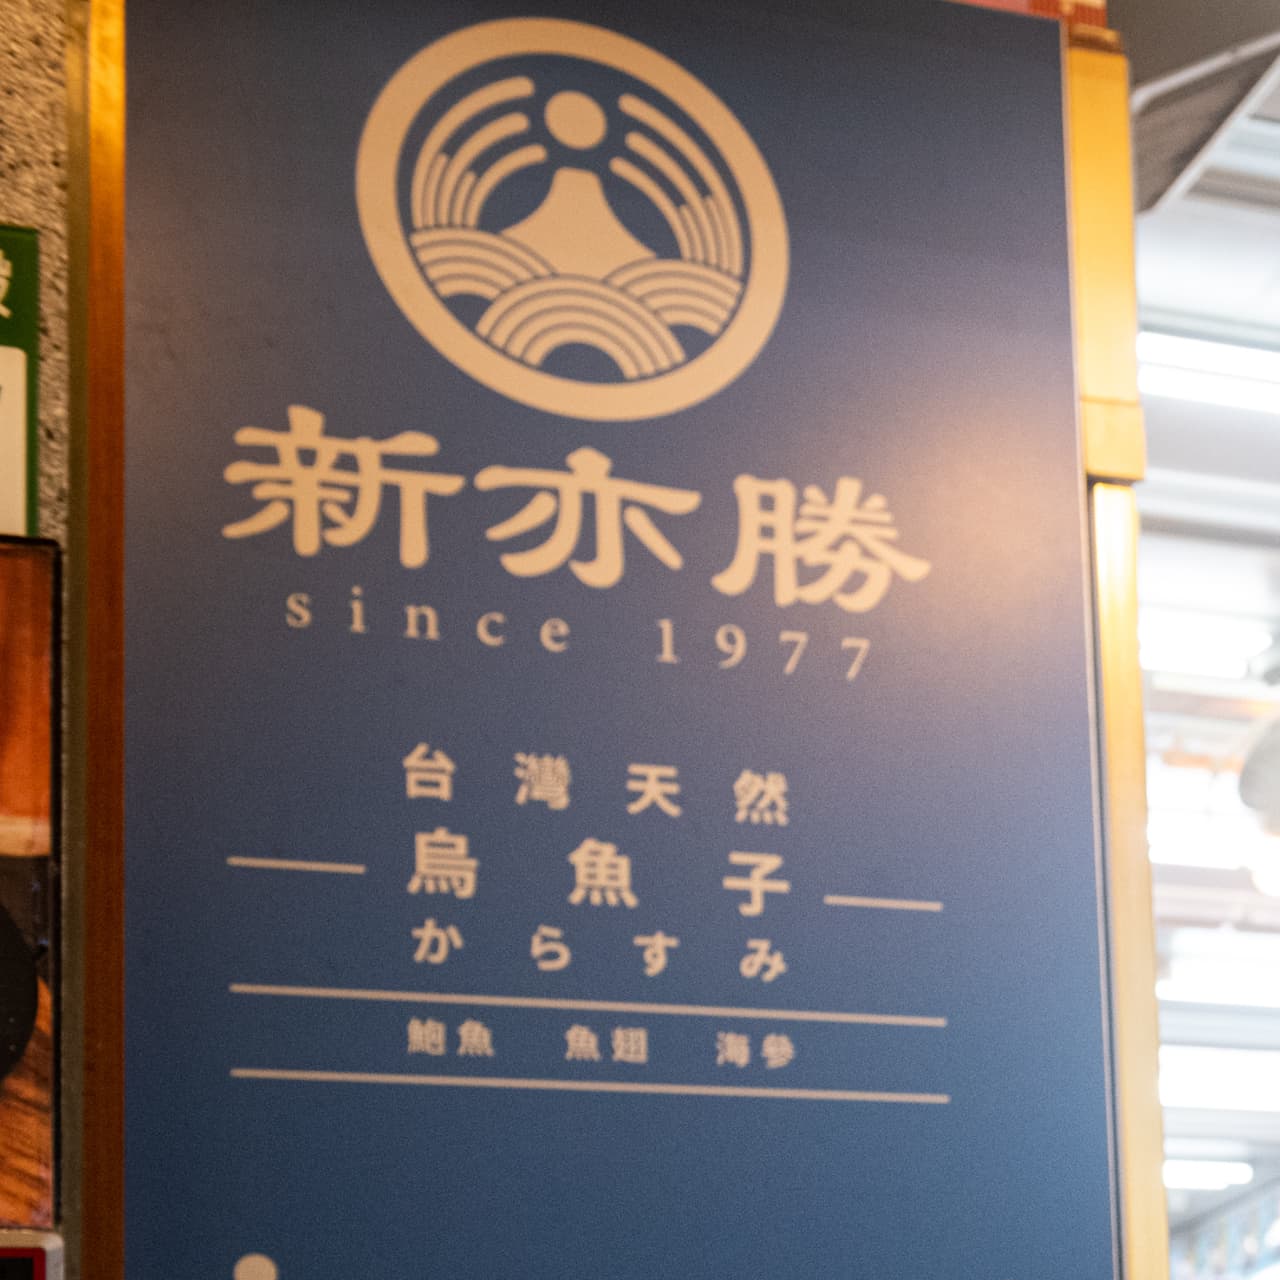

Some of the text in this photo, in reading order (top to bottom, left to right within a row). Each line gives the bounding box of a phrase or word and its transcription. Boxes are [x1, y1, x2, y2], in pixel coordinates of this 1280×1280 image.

[223, 405, 931, 612] 新亦勝
[286, 588, 873, 681] since 1977
[402, 742, 789, 826] 台灣天然
[407, 827, 790, 916] 烏魚子
[411, 918, 787, 983] からすみ
